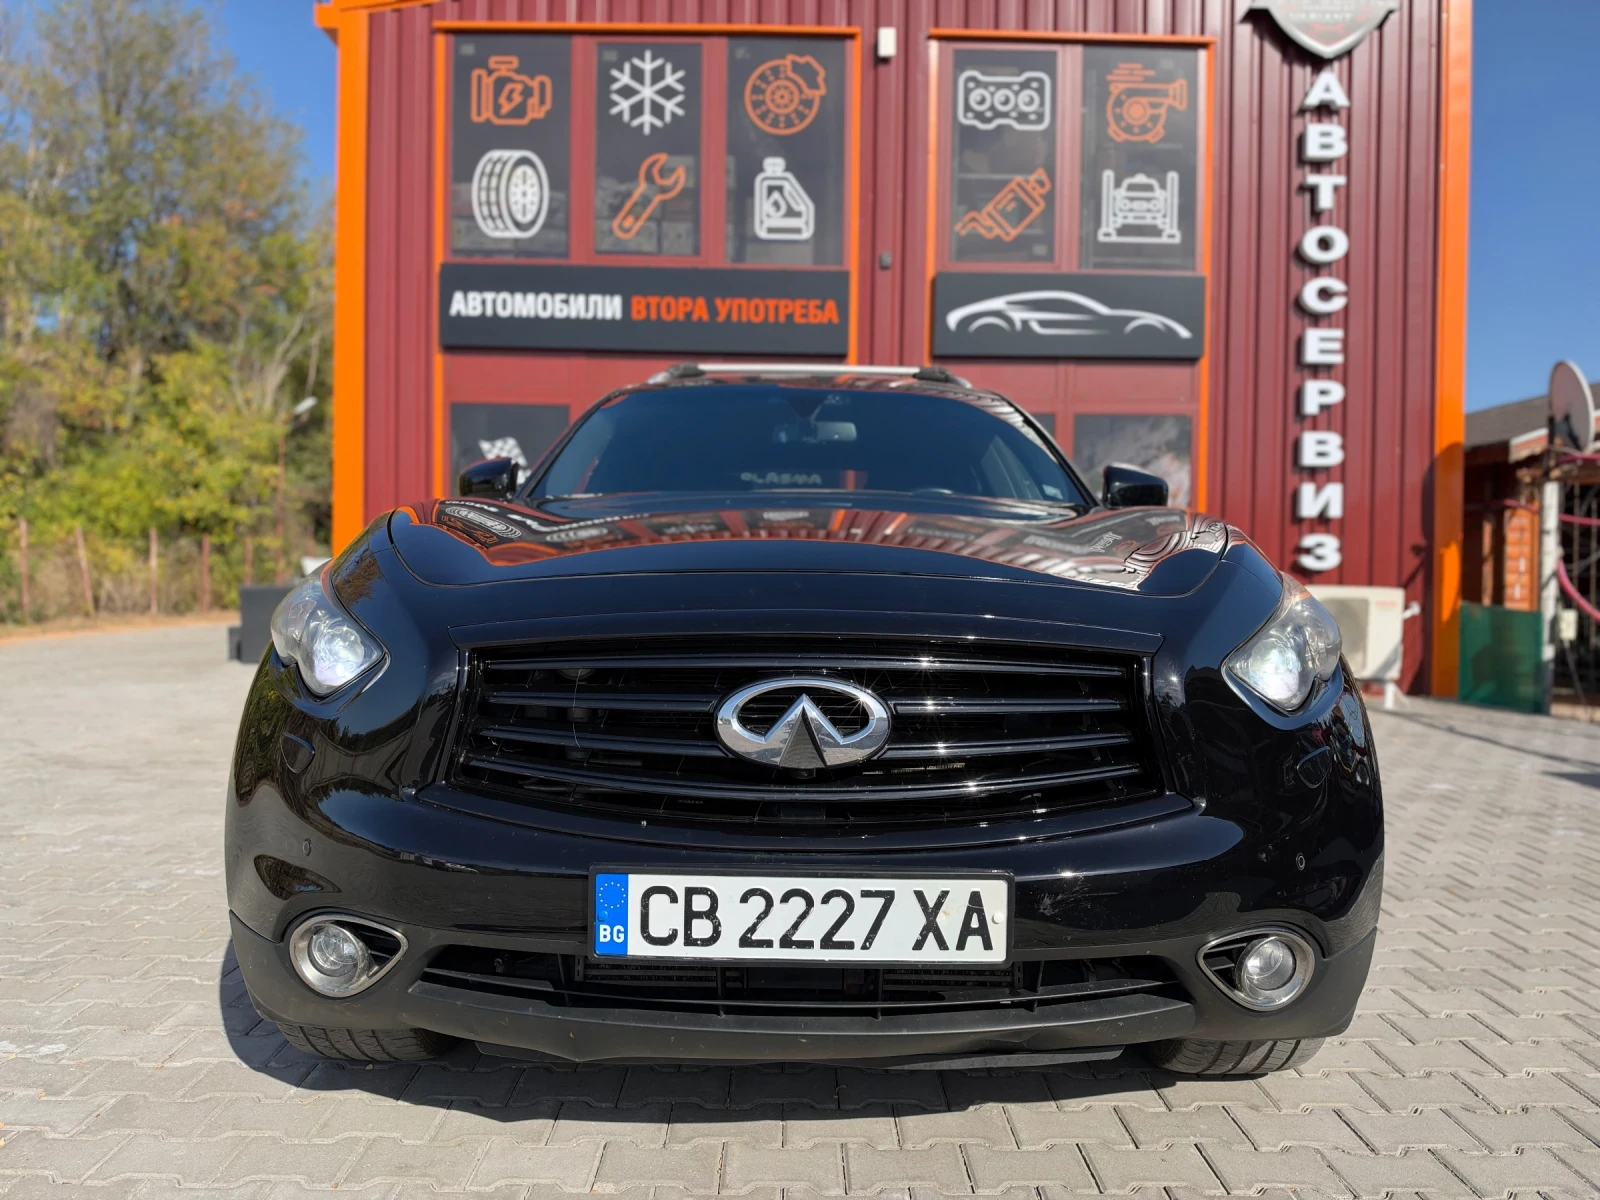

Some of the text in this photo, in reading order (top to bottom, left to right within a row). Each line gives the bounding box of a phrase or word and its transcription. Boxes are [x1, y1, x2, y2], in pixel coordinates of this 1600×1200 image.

[449, 290, 840, 325] АВТОМОБИЛИ ВТОРА УПОТРЕБА
[1295, 71, 1350, 572] АВТОСЕРВИЗ
[598, 925, 625, 943] BG
[640, 885, 993, 951] CB 2227 XA
